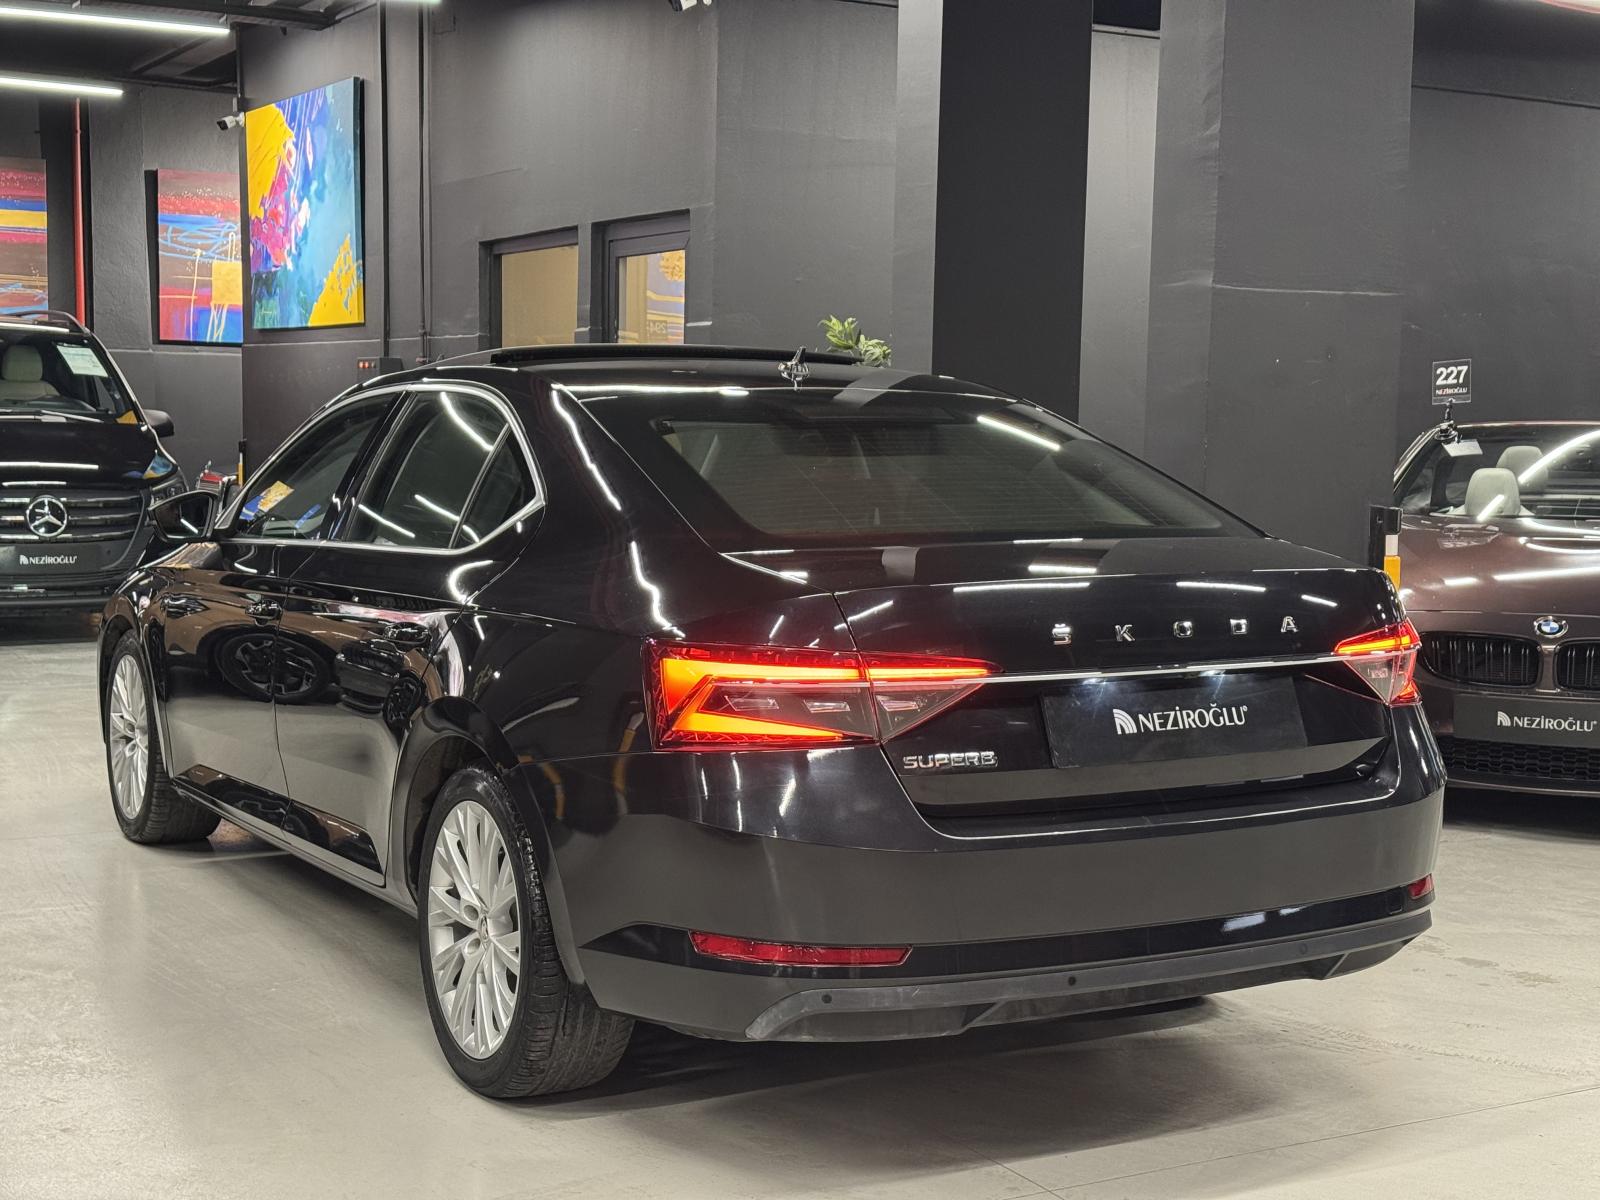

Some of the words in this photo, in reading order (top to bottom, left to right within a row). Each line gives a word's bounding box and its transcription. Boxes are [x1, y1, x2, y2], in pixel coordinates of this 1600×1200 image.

[1436, 365, 1469, 385] 227
[1137, 702, 1246, 733] NEZİROĞLU
[1513, 715, 1595, 732] NEZİROĞLU
[902, 750, 998, 769] SUPERB
